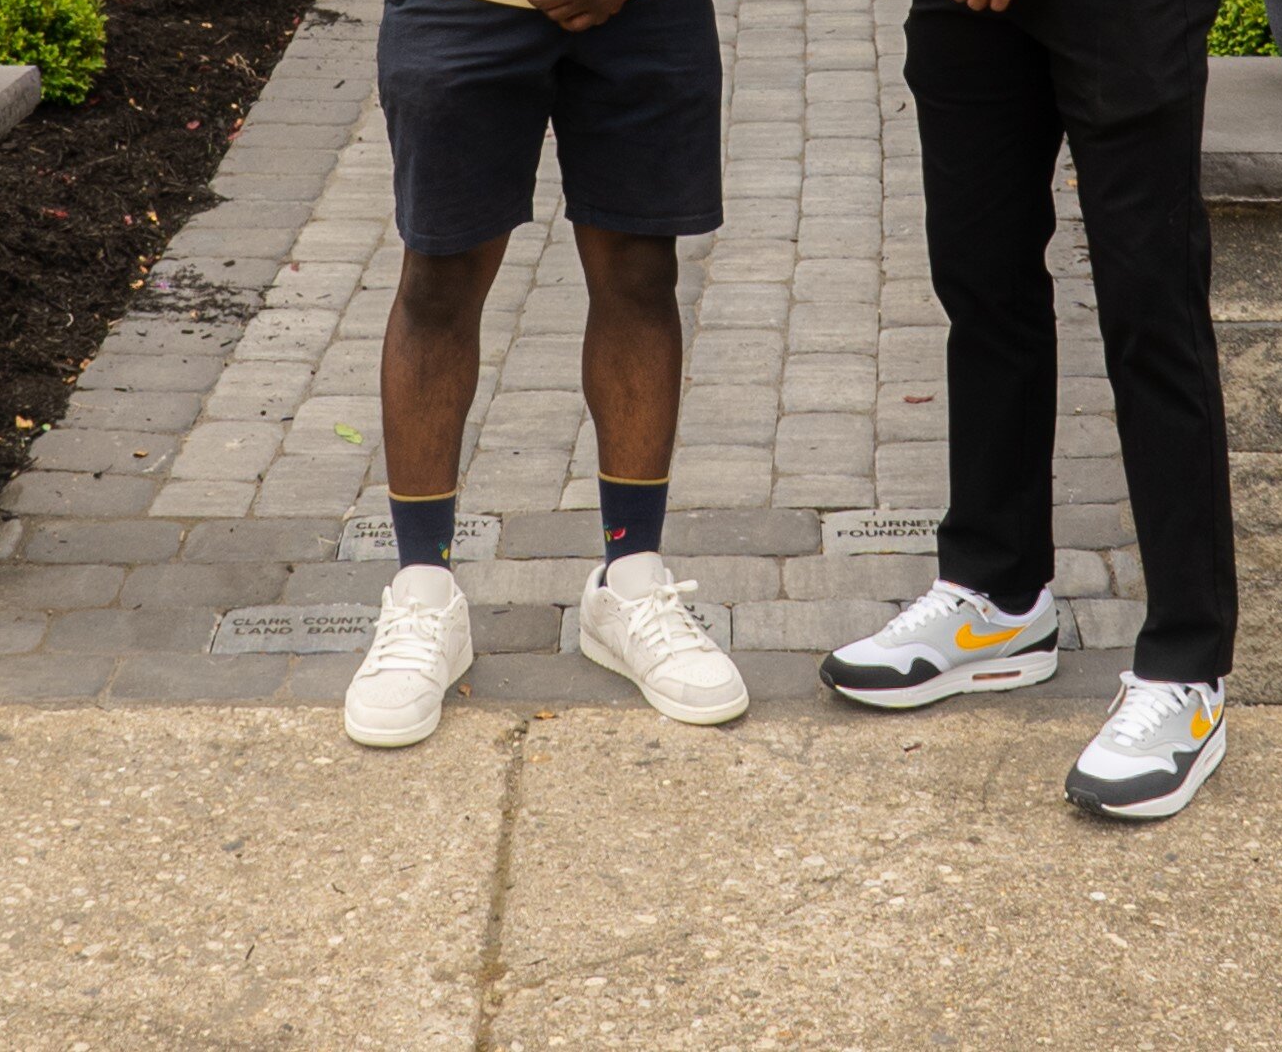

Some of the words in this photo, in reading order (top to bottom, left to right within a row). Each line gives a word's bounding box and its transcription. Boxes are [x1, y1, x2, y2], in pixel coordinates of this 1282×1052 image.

[836, 528, 937, 538] FOUNDATI
[232, 617, 292, 627] CLARK
[303, 616, 377, 625] COUNTY
[234, 626, 293, 636] LAND
[307, 625, 366, 635] BANK
